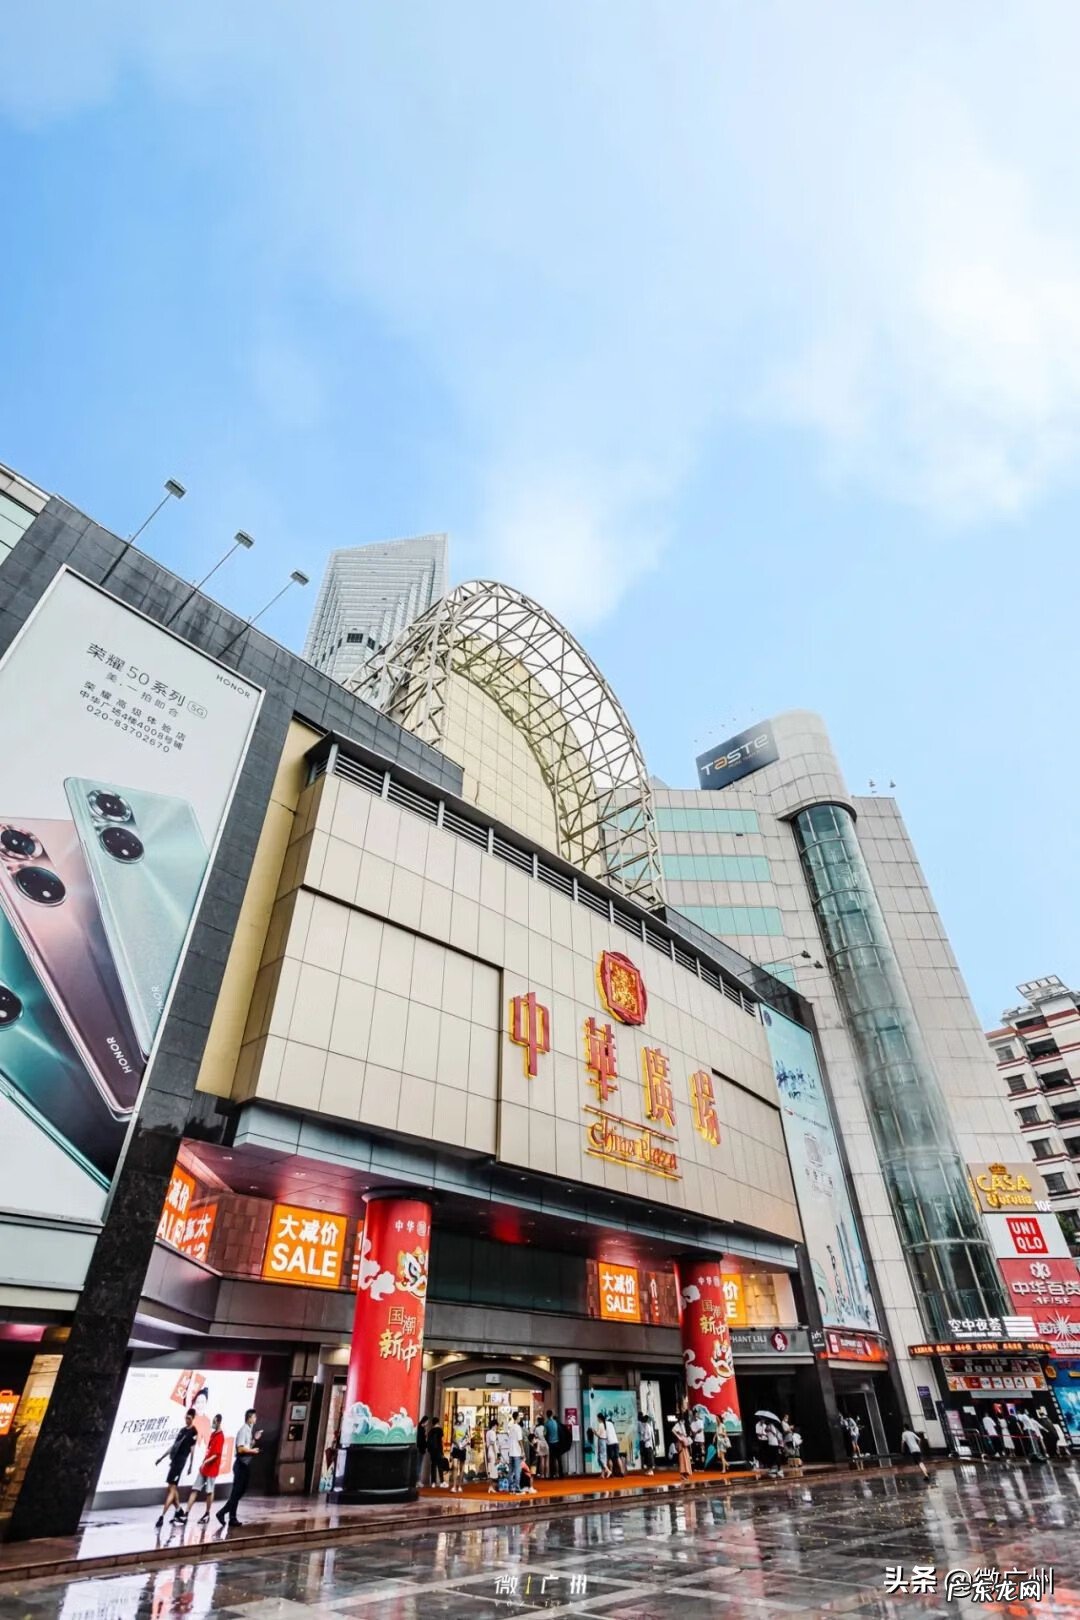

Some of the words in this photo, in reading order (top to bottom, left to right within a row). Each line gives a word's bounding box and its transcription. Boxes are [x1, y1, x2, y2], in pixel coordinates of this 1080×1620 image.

[216, 674, 250, 698] HONOR
[86, 704, 170, 753] 020-83702670
[106, 1036, 132, 1074] HONOR
[587, 1114, 636, 1158] China
[636, 1129, 678, 1171] Plaza
[976, 1174, 1032, 1192] CASA
[277, 1213, 340, 1248] 大减价
[1010, 1222, 1037, 1235] UNI
[1015, 1236, 1043, 1252] QLO
[270, 1242, 338, 1279] SALE
[602, 1271, 636, 1296] 大减价
[1011, 1281, 1080, 1297] 中华百货
[606, 1294, 637, 1315] SALE
[388, 1306, 417, 1335] 国潮
